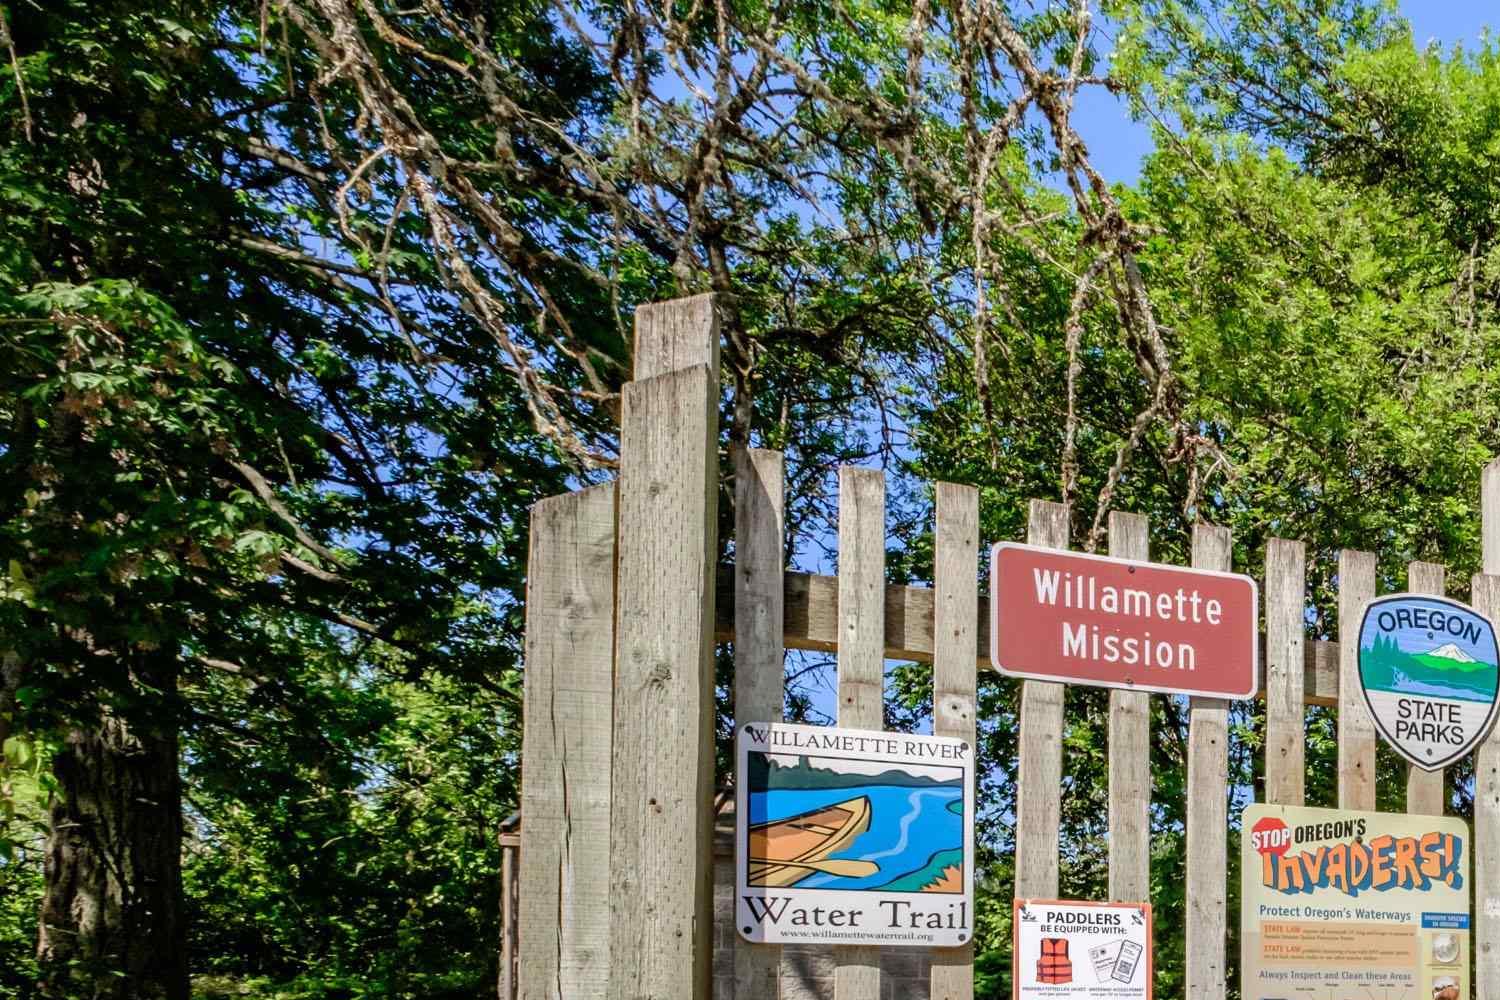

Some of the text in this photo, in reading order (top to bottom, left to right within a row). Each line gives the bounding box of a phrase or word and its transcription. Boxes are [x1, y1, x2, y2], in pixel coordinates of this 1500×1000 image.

[1033, 567, 1222, 625] Willamette
[1378, 608, 1482, 645] OREGON
[1062, 622, 1195, 671] Mission
[1397, 699, 1462, 724] STATE
[750, 730, 965, 760] WILLAMETTE RIVER
[1395, 720, 1464, 745] PARKS
[1251, 818, 1366, 848] STOP OREGON'S
[742, 896, 968, 929] Water Trail
[1047, 911, 1121, 926] PADDLERS
[1259, 905, 1300, 917] Protect
[1304, 907, 1351, 920] Oregon's
[1355, 909, 1411, 922] Waterways
[780, 930, 934, 942] www.willamettewatertrail.org
[1054, 925, 1100, 934] EQUIPPED
[1259, 970, 1411, 981] Always Inspect and Clean these Areas
